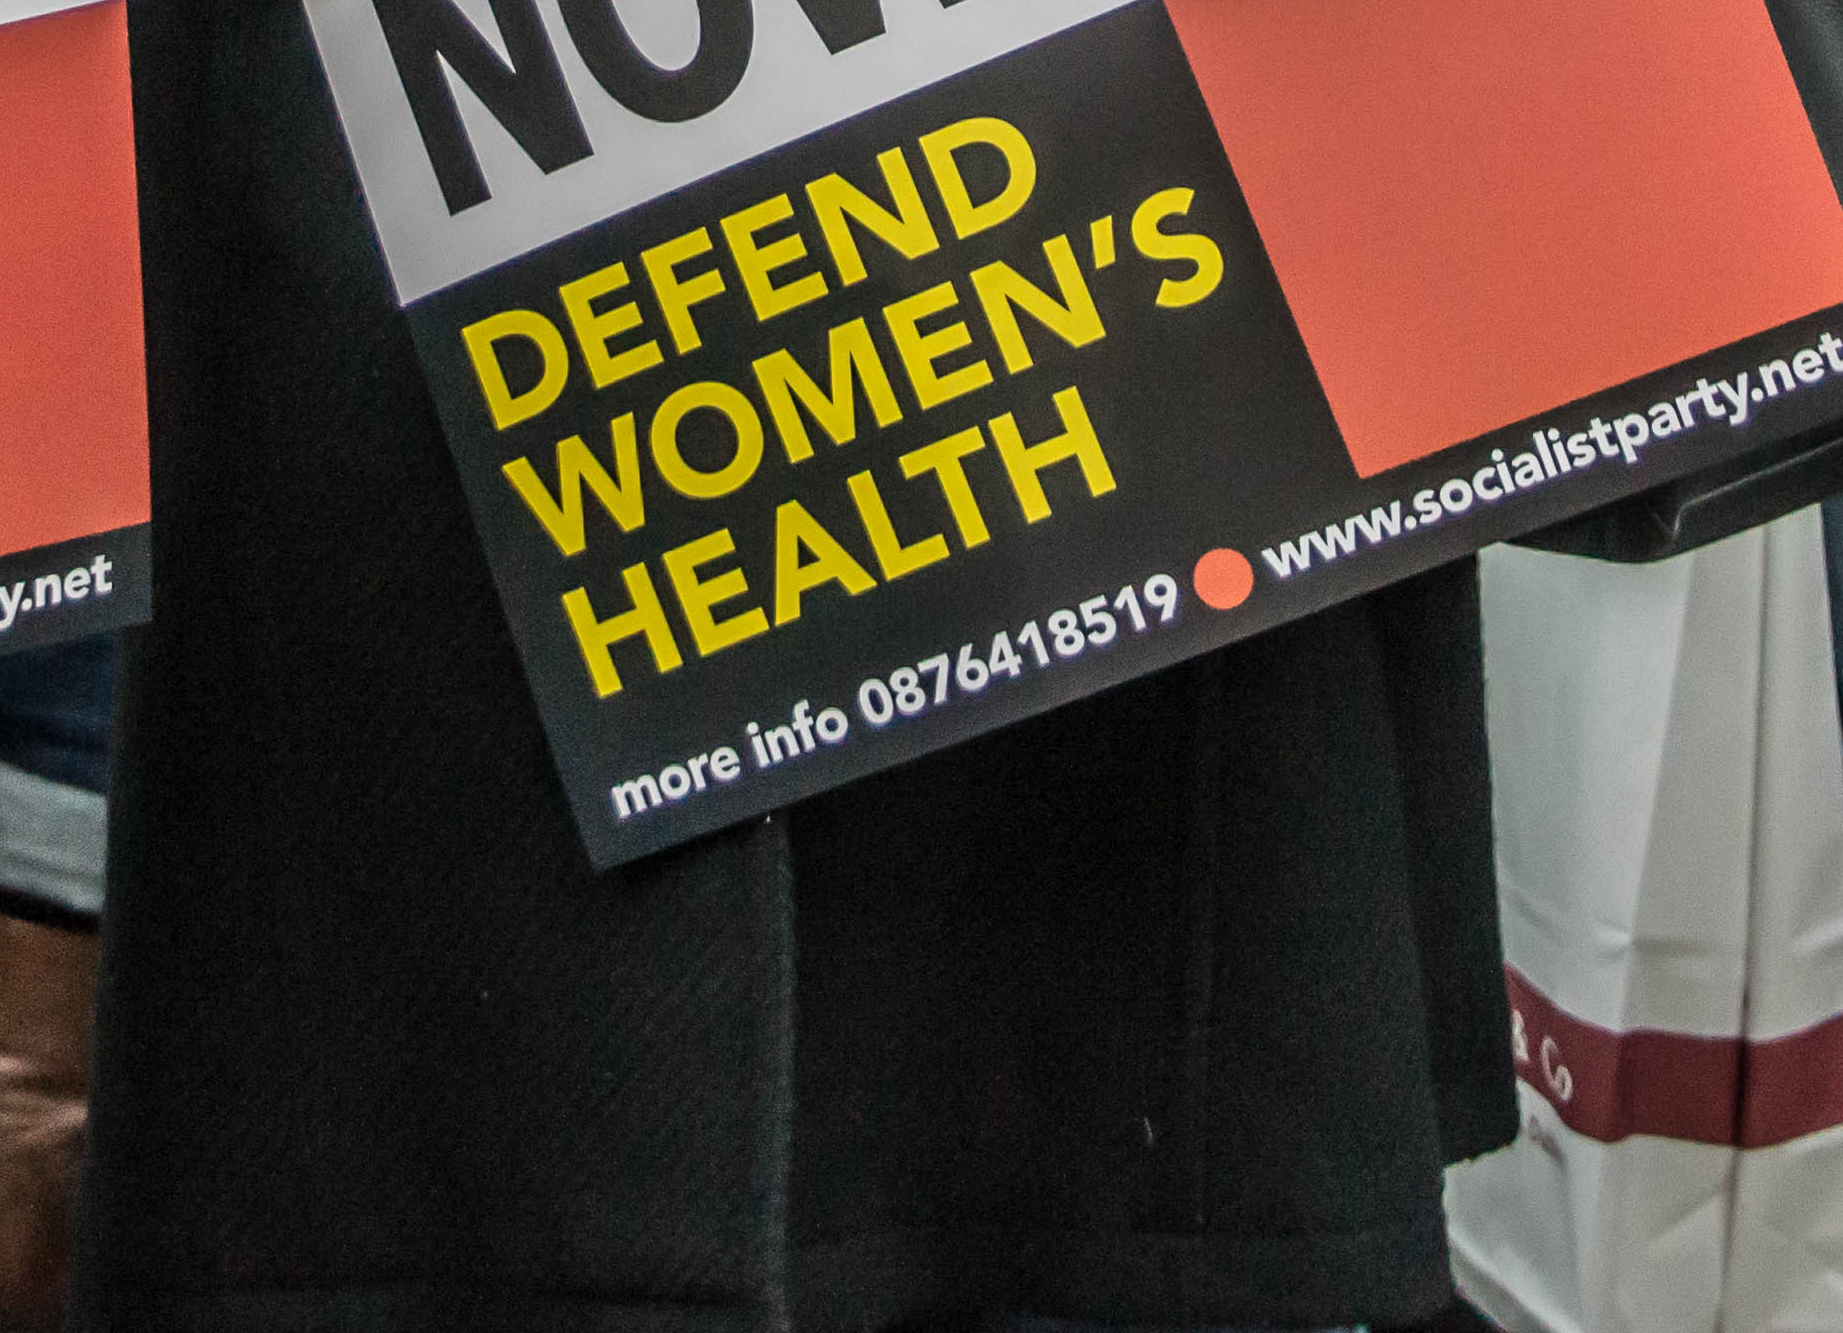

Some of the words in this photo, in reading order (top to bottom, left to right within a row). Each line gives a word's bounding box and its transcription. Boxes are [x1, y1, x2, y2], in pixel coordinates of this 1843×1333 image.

[459, 115, 1038, 433] DEFEND
[500, 186, 1228, 559] WOMEN'S
[560, 385, 1118, 702] HEALTH
[609, 745, 744, 822] more
[747, 694, 851, 769] info
[856, 572, 1181, 733] 0876418519
